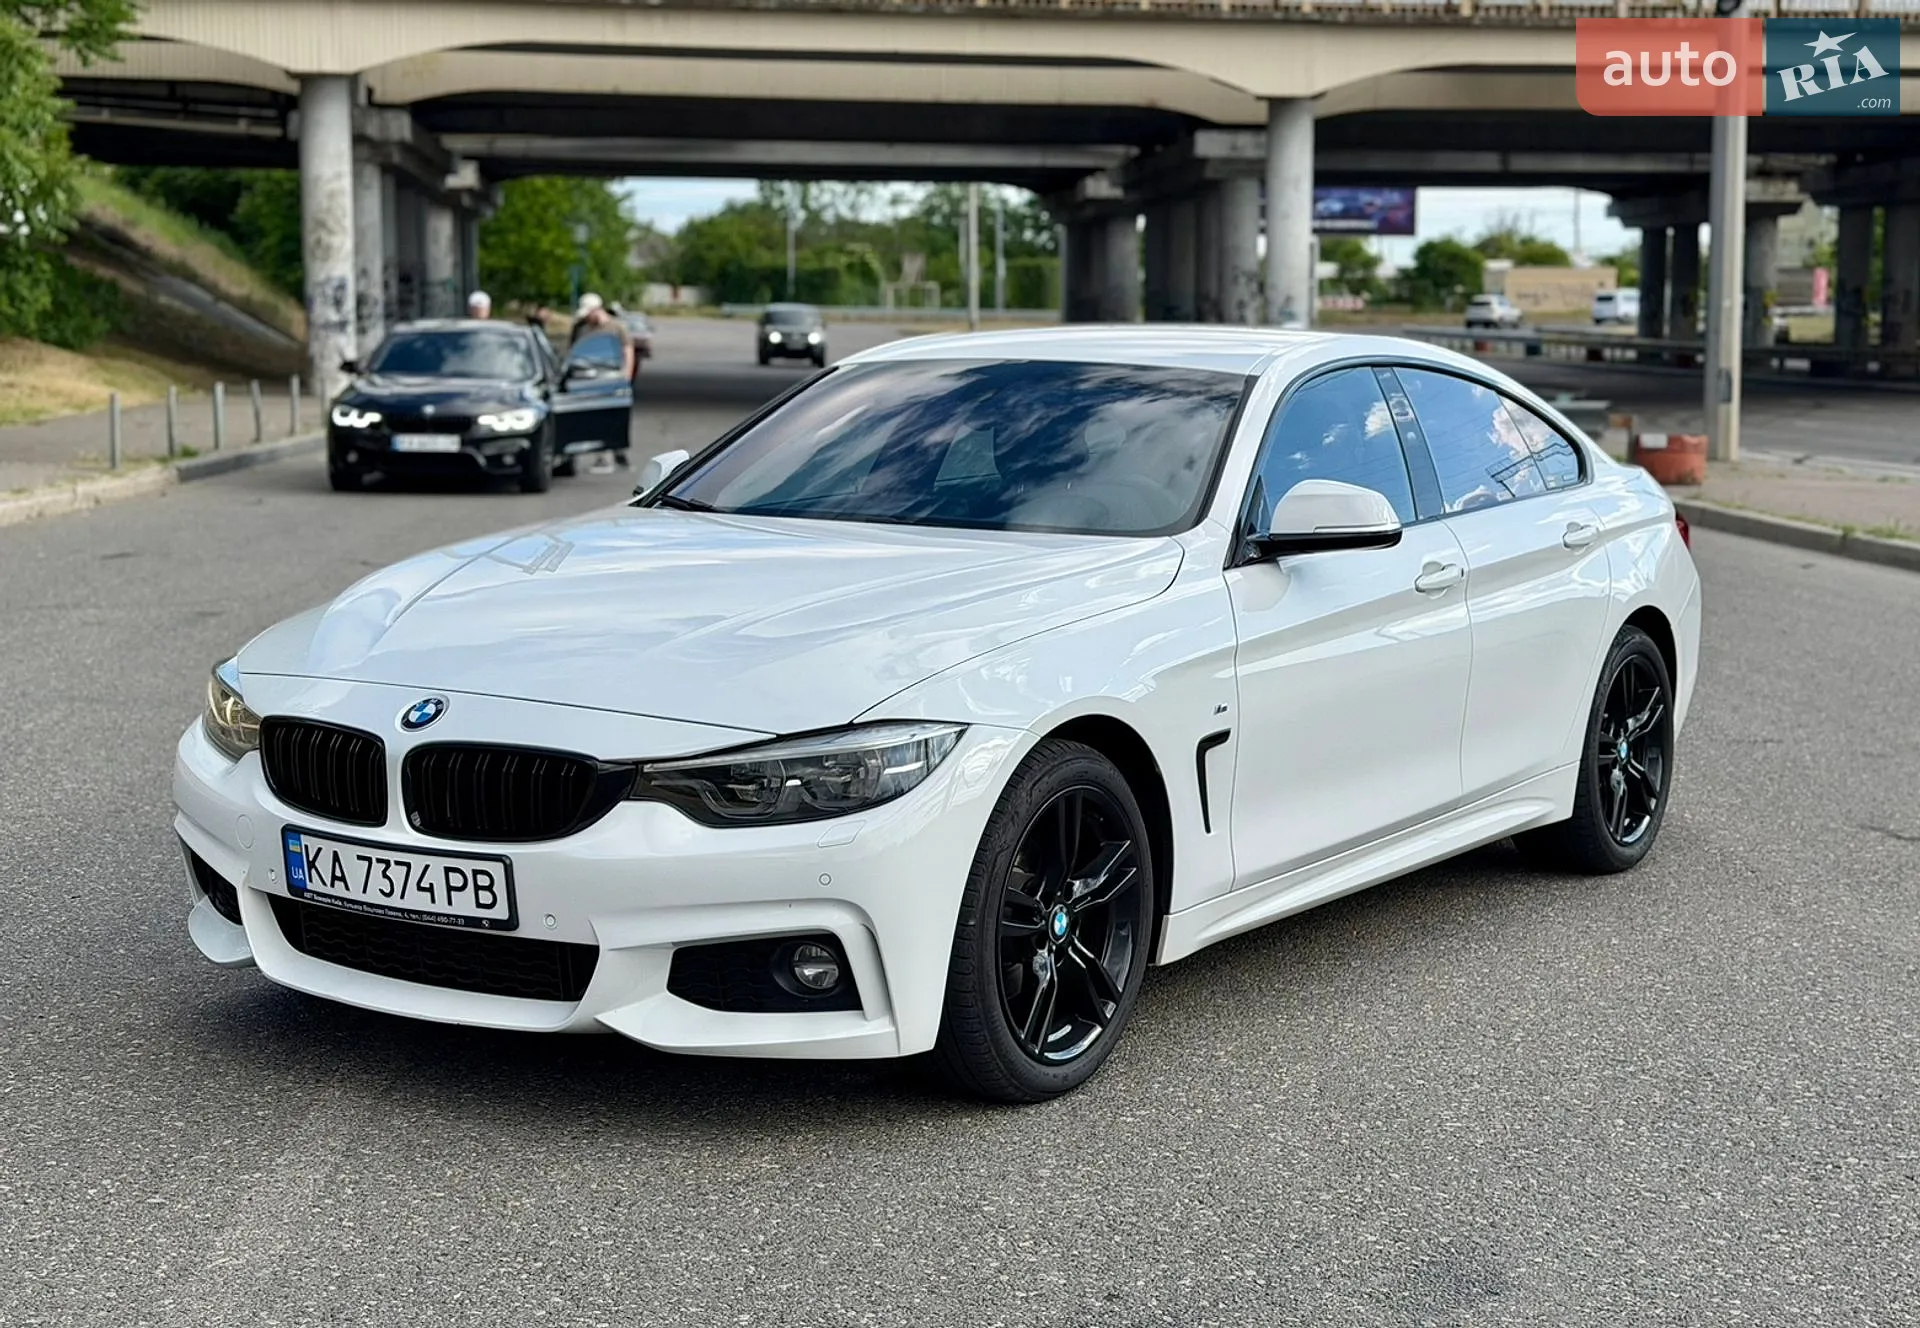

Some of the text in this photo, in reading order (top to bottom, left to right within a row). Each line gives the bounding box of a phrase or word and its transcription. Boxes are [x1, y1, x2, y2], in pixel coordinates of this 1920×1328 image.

[291, 865, 305, 881] UA
[304, 844, 351, 892] KA
[356, 854, 436, 905] 7374
[443, 866, 498, 910] PB
